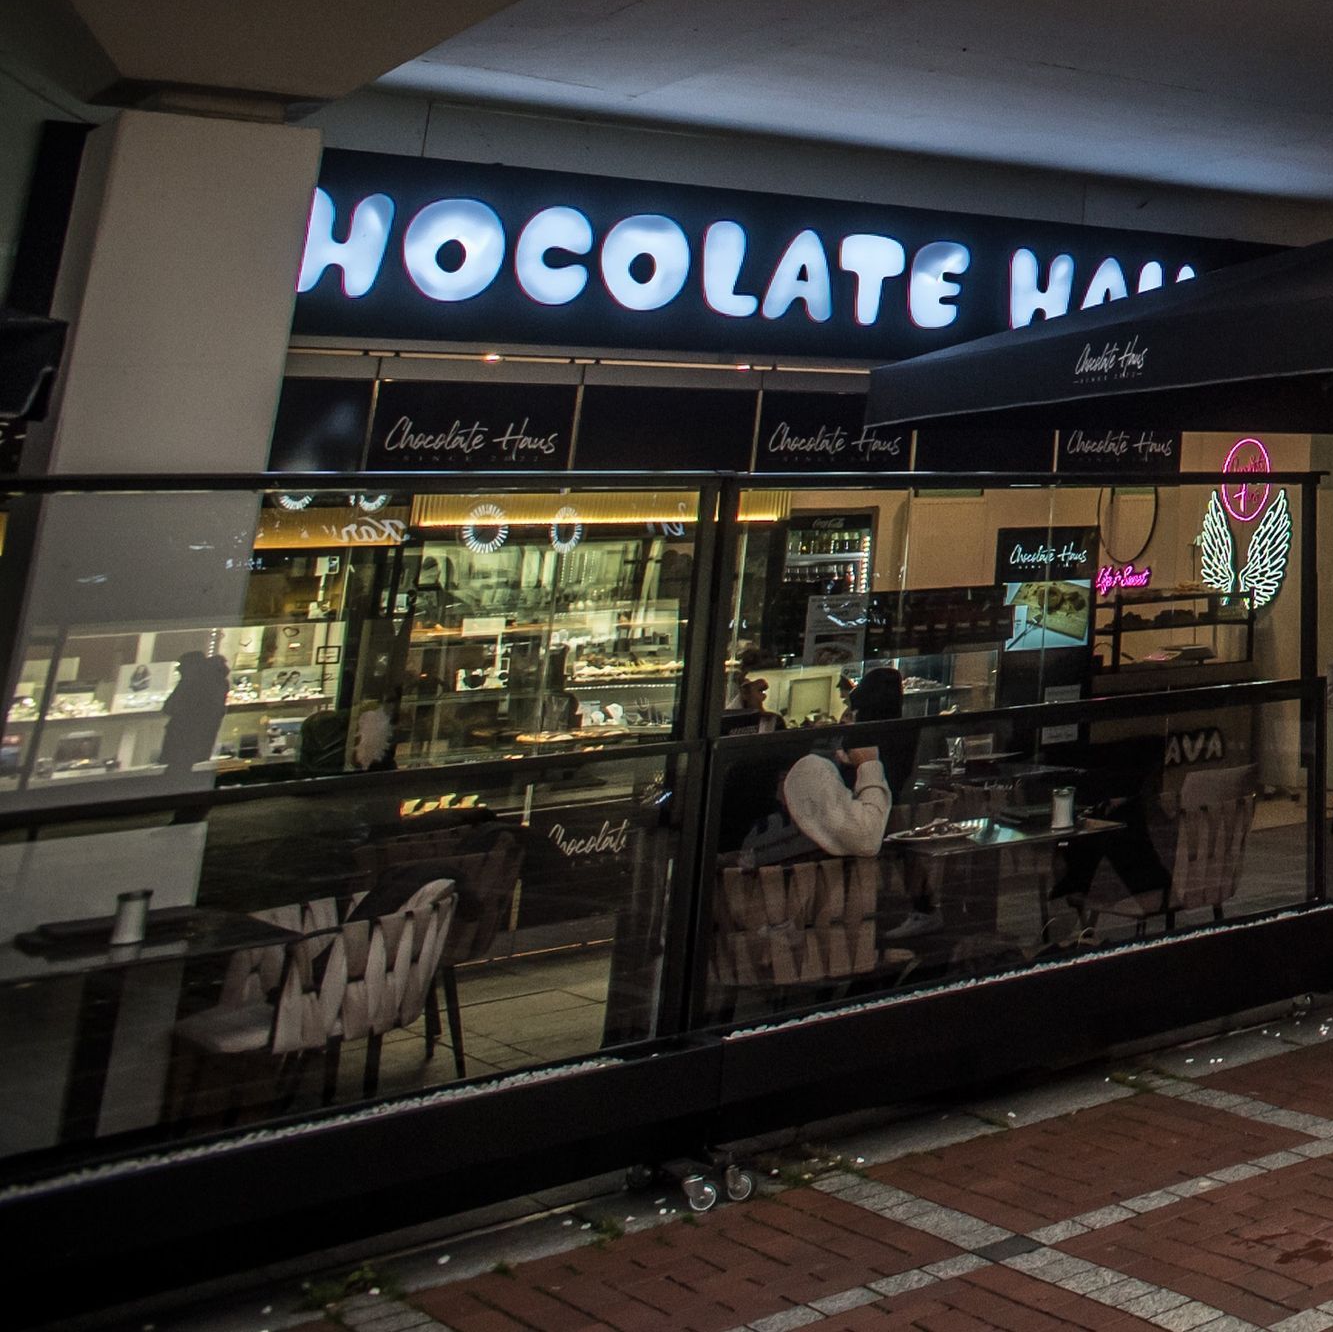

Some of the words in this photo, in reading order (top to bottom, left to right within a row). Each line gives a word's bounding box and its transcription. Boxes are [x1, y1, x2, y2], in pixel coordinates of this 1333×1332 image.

[384, 415, 489, 454] Chocolate
[491, 416, 560, 461] Haus
[768, 421, 848, 456] Chocolate
[850, 424, 903, 462] Haus
[1066, 429, 1131, 456] Chocolate
[1131, 430, 1173, 463] Haus
[1009, 543, 1057, 566] Chocolate
[1056, 541, 1088, 567] Haus
